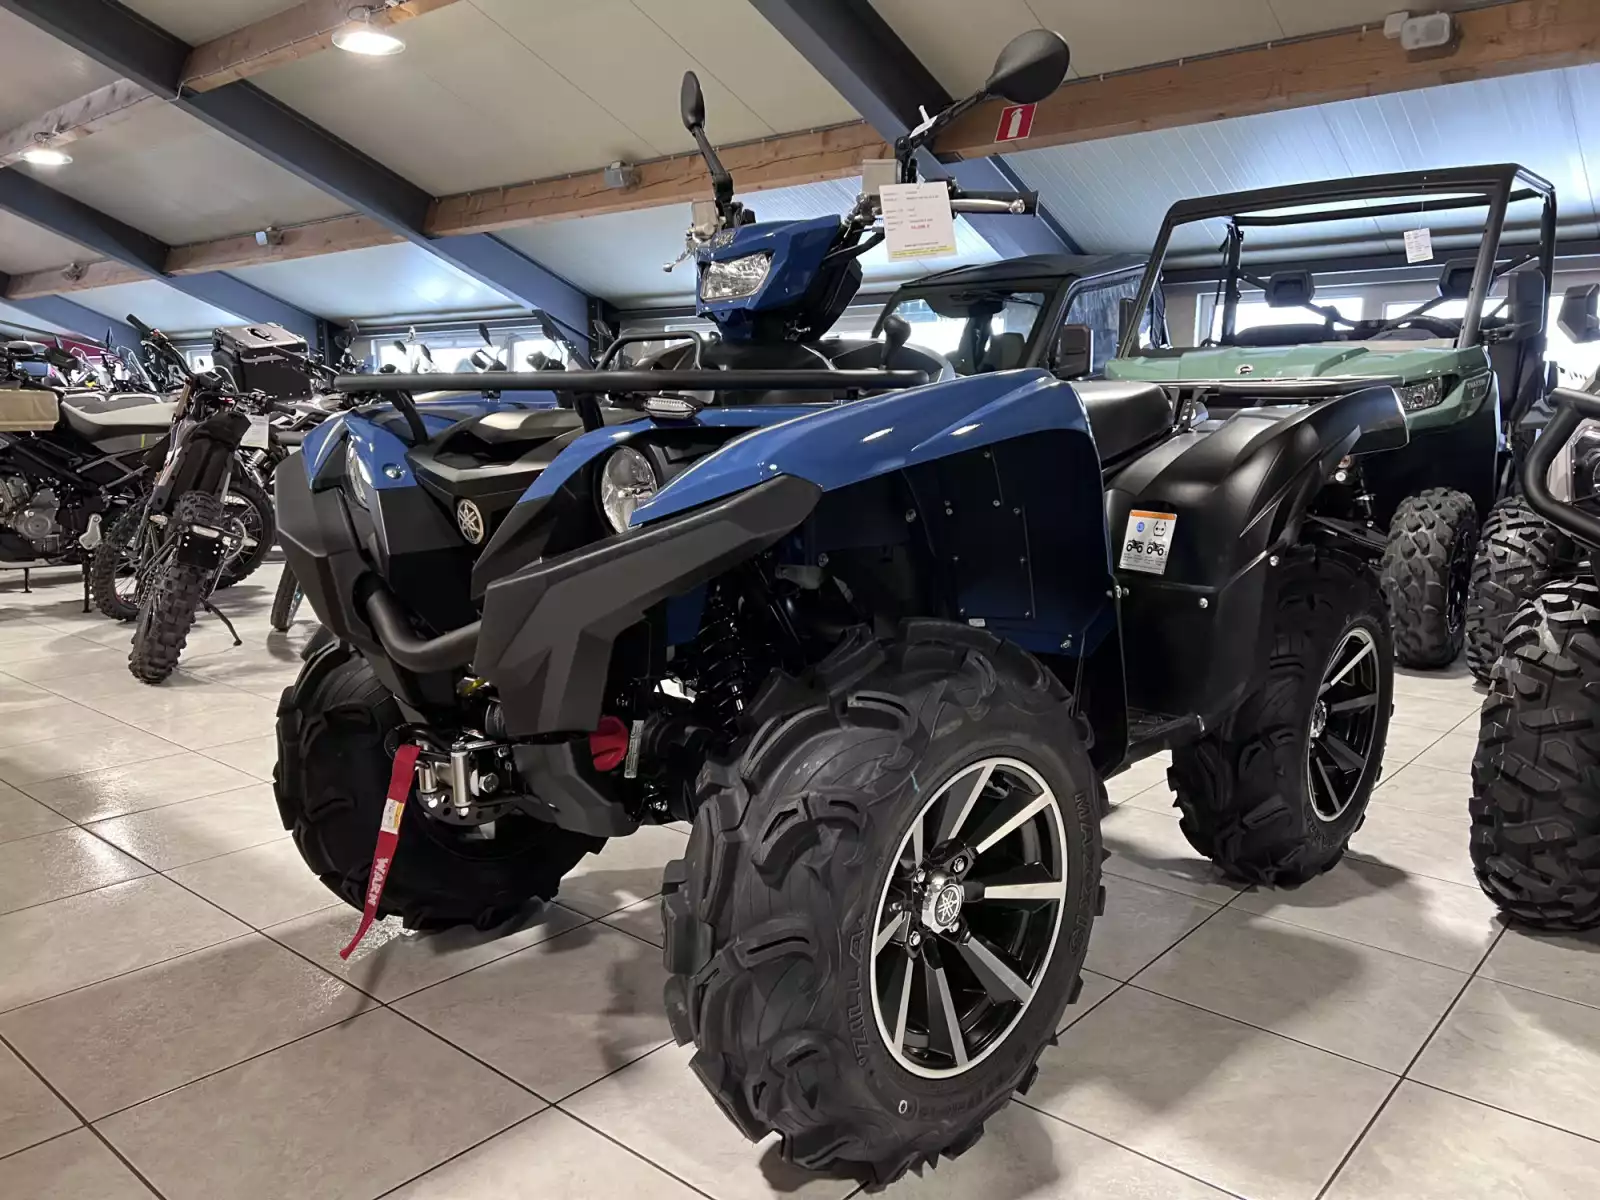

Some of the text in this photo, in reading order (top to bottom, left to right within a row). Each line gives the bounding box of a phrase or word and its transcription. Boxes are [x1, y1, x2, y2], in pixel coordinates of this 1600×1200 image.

[368, 858, 389, 906] WARN
[1069, 792, 1099, 956] MAXXIS
[847, 928, 869, 1060] ZILLA
